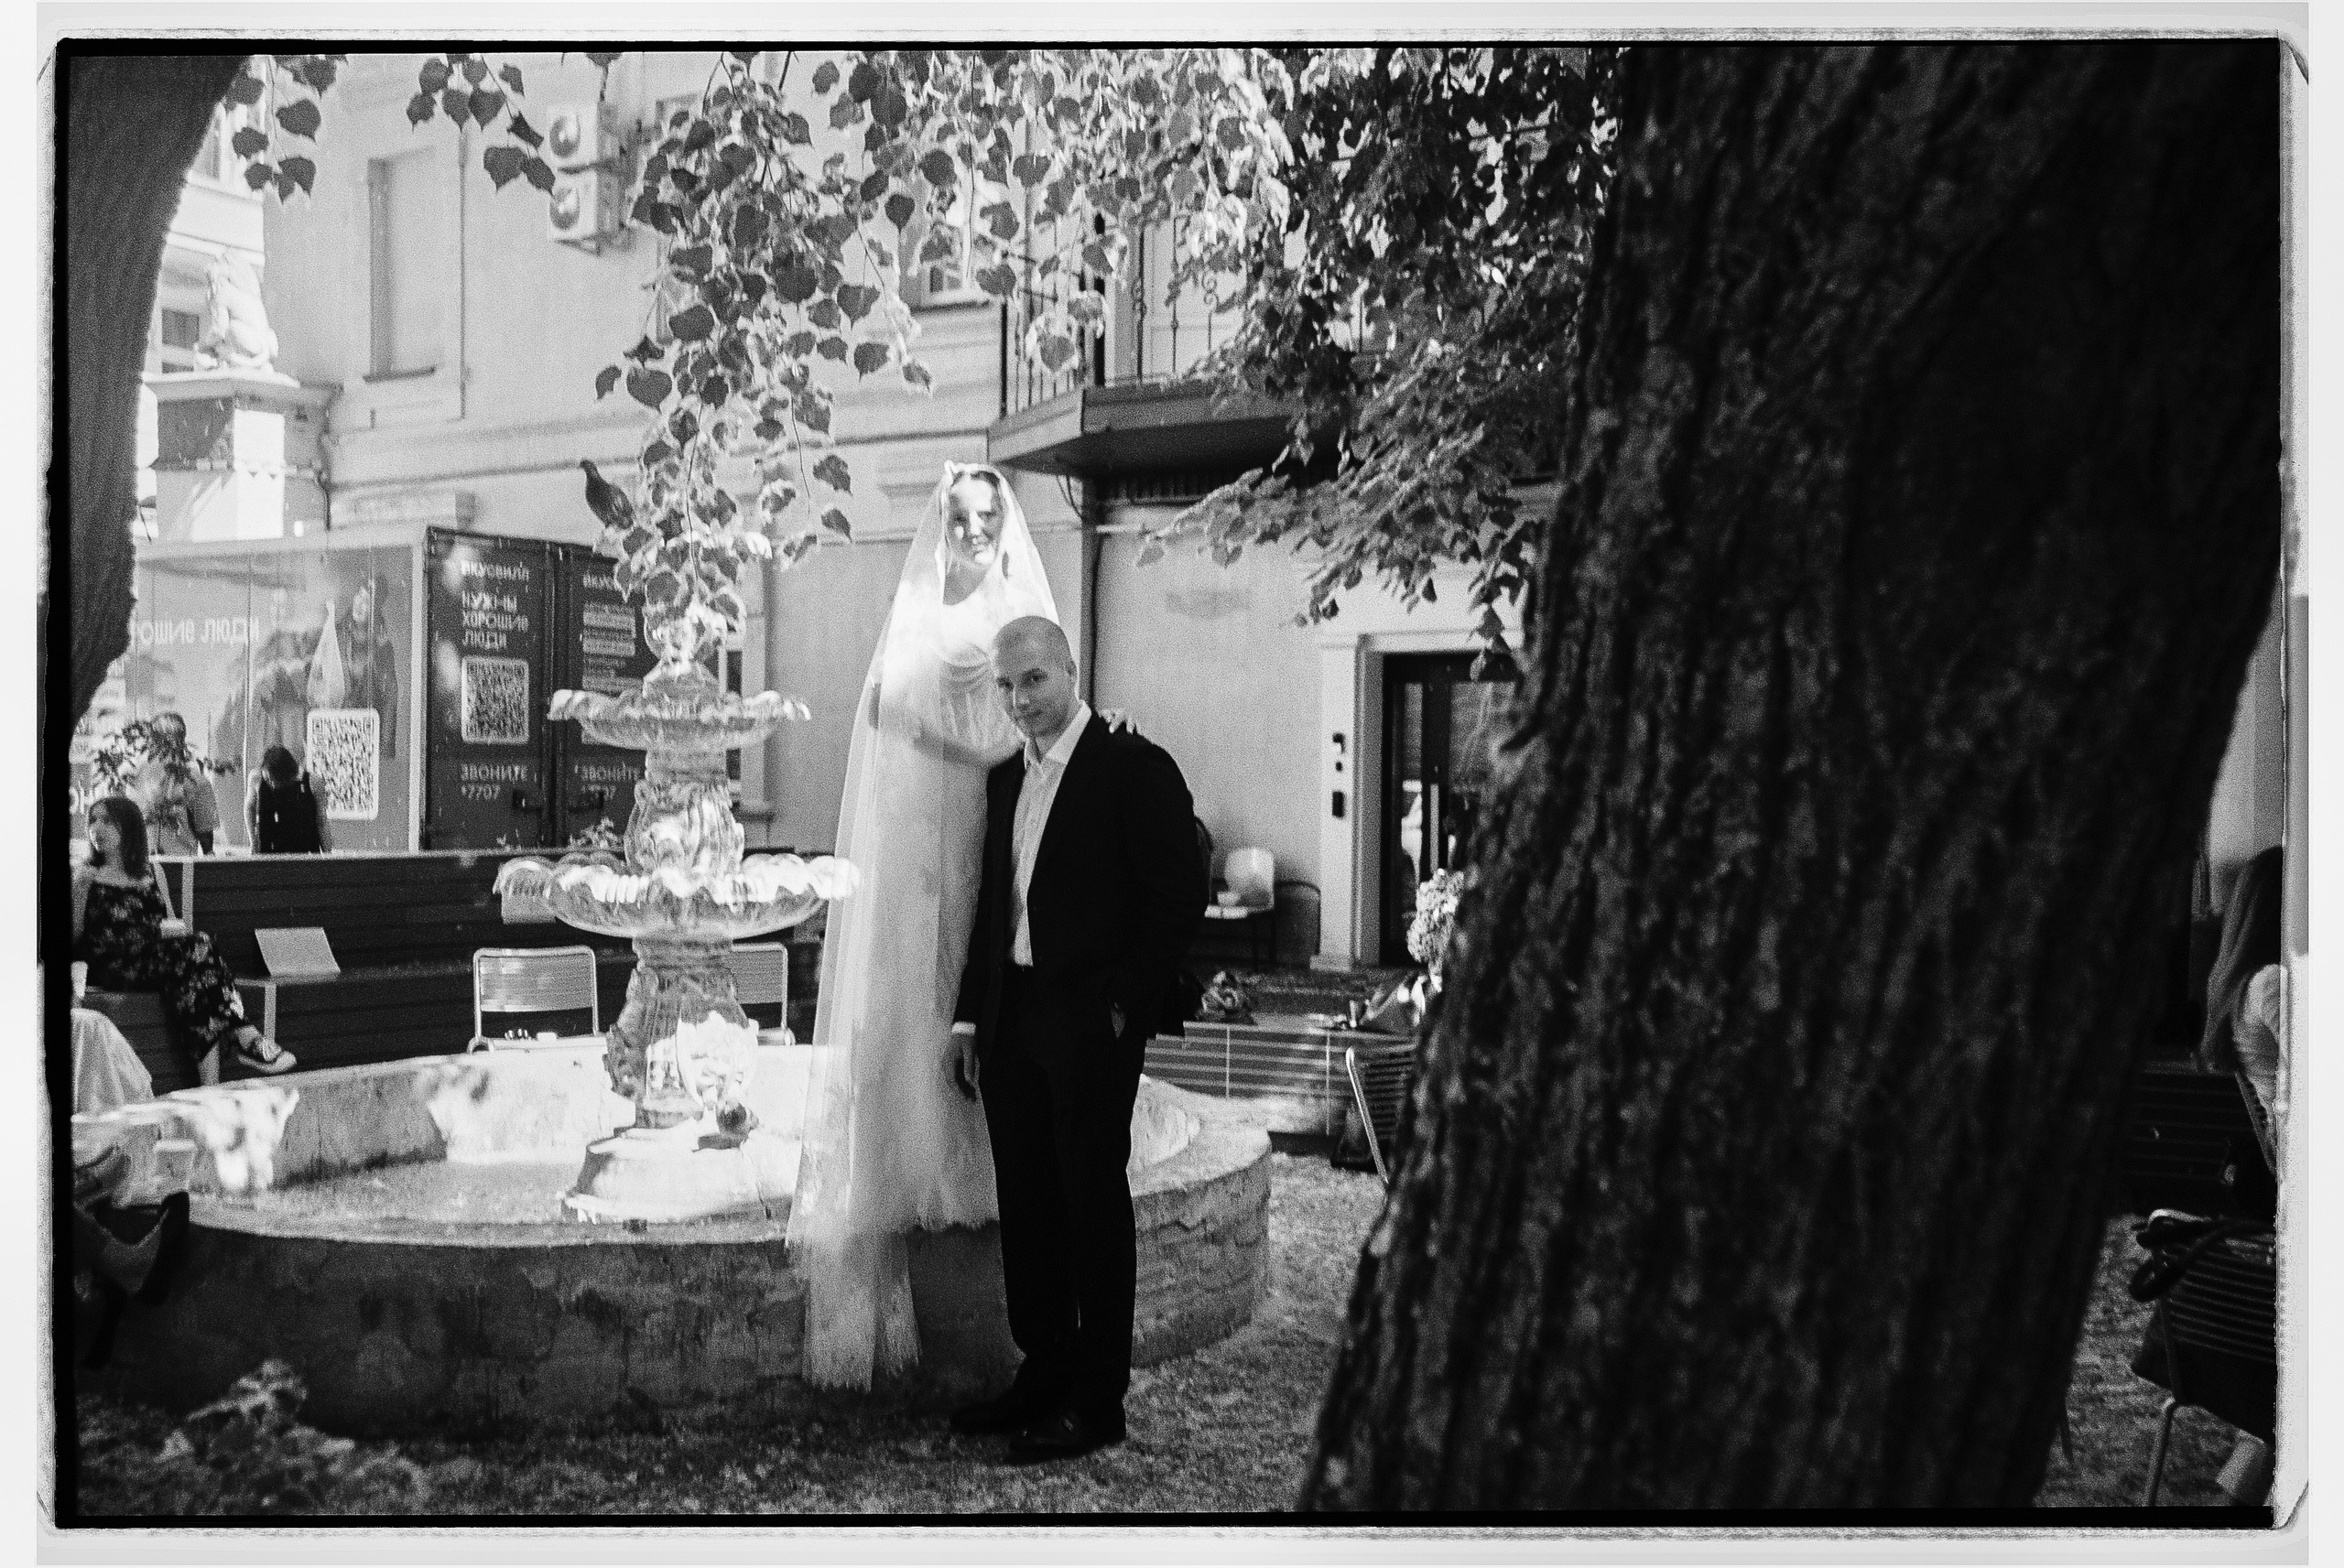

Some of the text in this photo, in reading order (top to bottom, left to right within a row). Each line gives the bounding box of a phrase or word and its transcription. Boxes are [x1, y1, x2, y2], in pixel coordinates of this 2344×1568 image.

[462, 593, 517, 611] НУЖНЫ
[462, 631, 507, 651] ЛЮДИ
[462, 763, 527, 781] ЗВОНИТЕ
